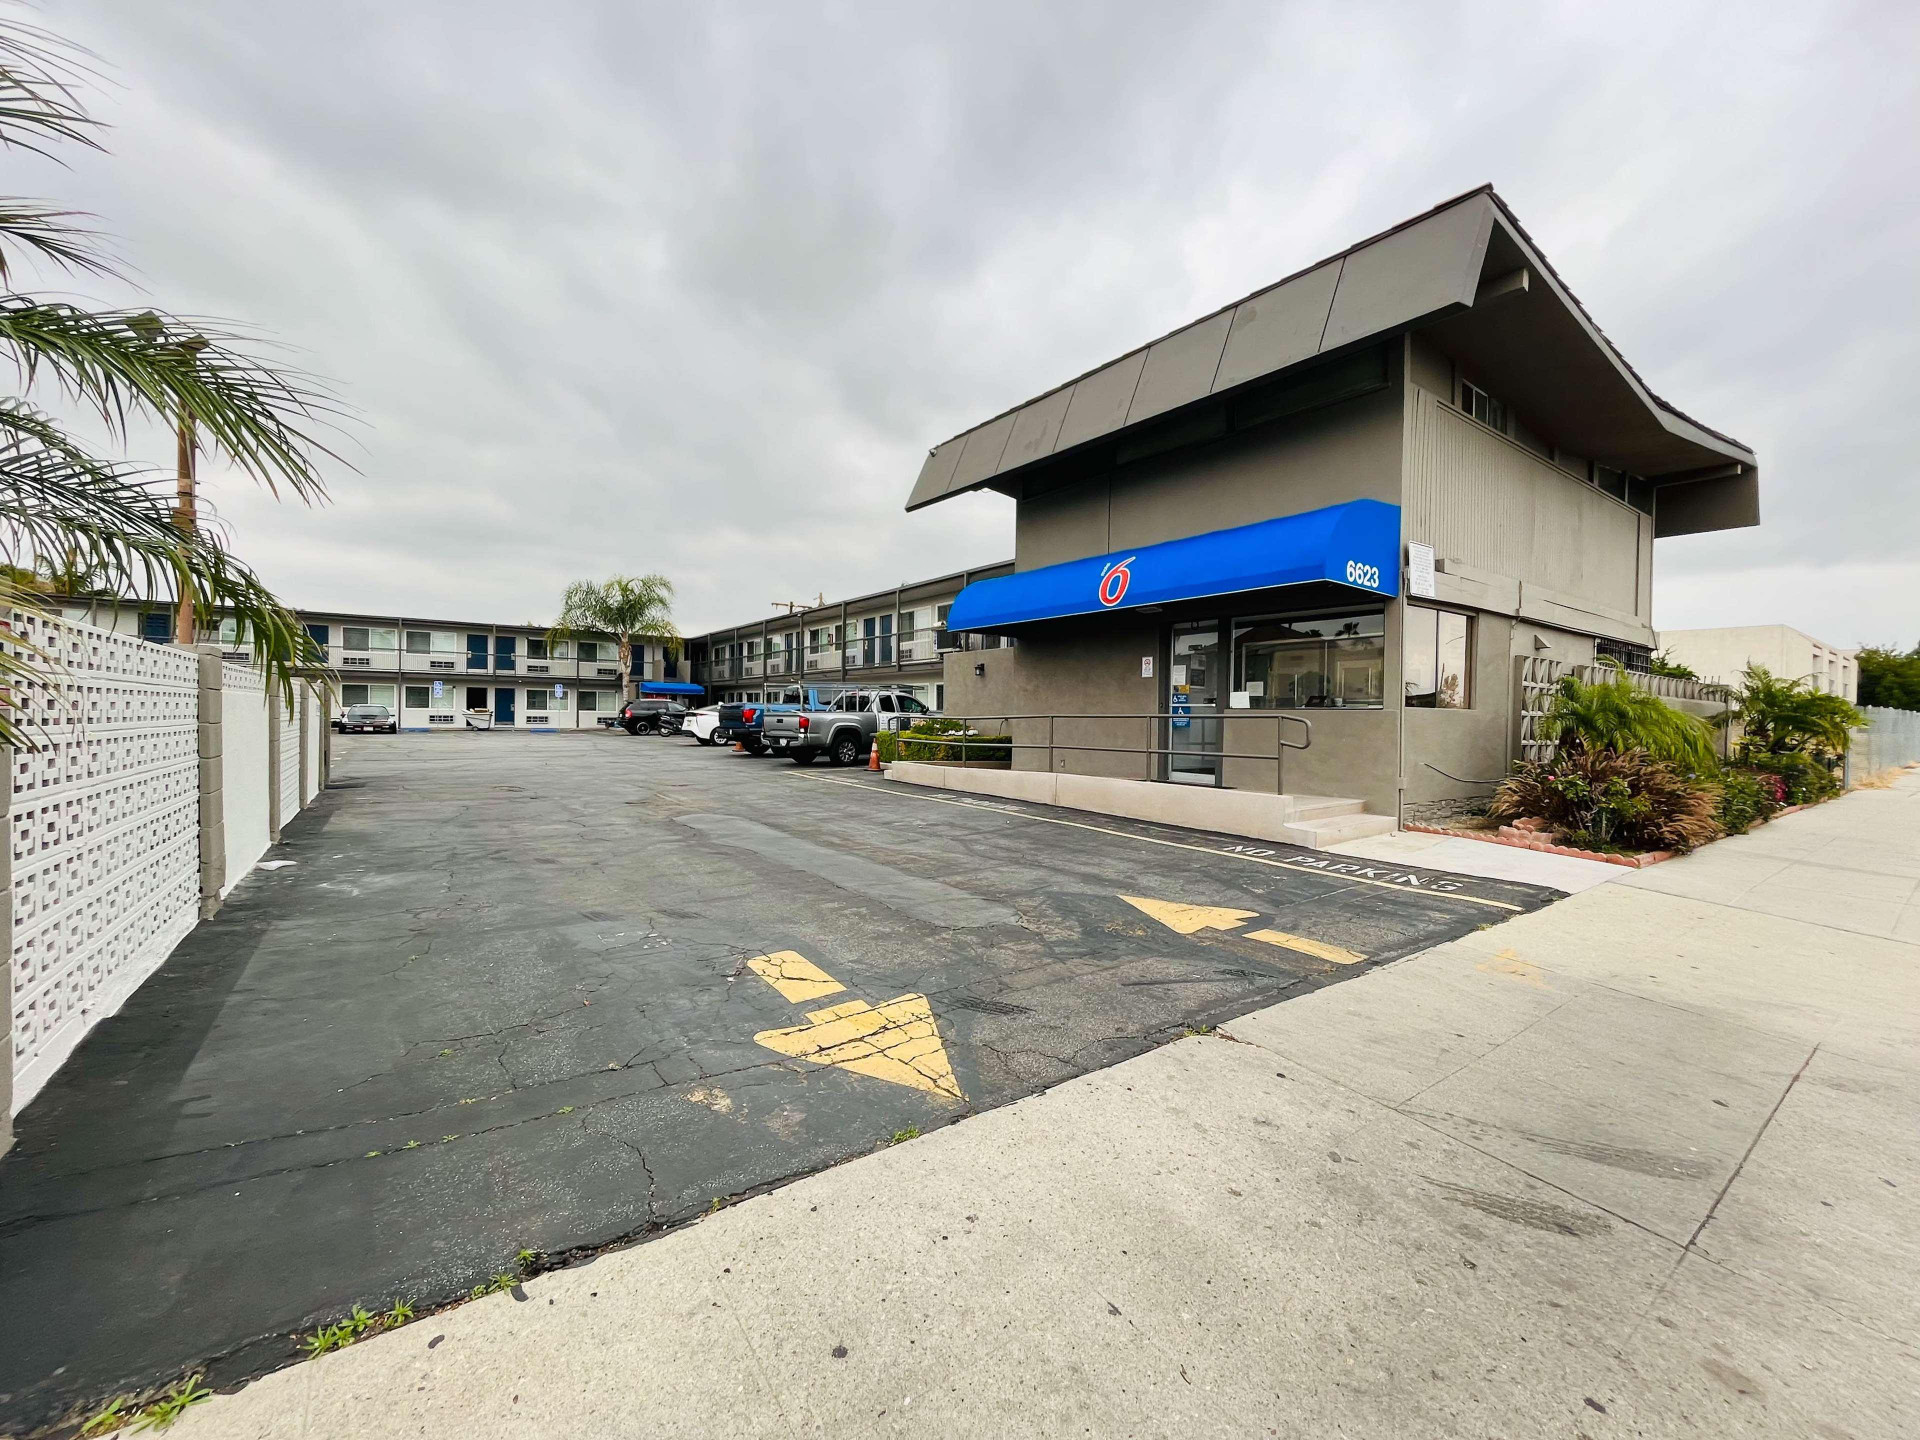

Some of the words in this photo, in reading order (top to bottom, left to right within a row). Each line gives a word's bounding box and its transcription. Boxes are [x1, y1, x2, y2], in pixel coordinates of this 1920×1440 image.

[1099, 556, 1136, 606] 6
[1347, 560, 1379, 588] 6623
[1223, 845, 1275, 857] NO
[1285, 856, 1464, 891] PARKING
